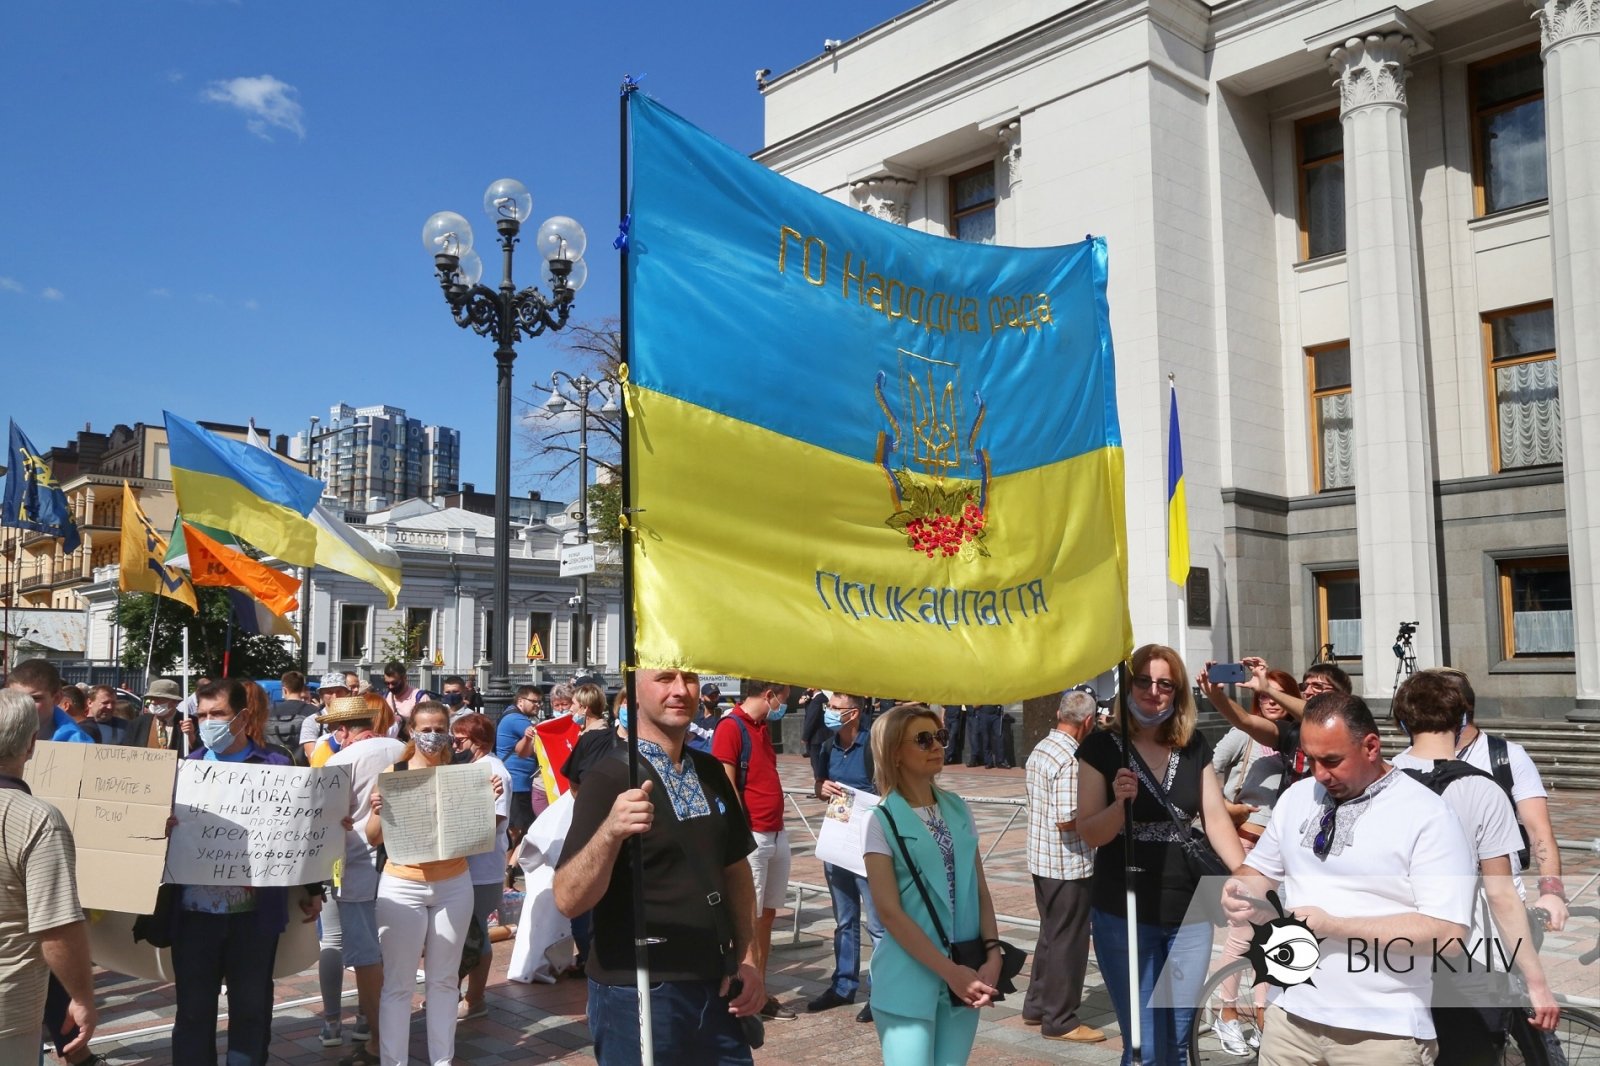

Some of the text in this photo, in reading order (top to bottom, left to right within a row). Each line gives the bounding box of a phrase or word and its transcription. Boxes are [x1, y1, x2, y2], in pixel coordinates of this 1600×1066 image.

[779, 225, 1053, 335] ГО Народна рада
[815, 570, 1049, 631] Прикарпаття
[194, 765, 341, 788] УКРАЇНСЬКА
[189, 803, 323, 819] ЦЕ НАША ЗБРОЯ
